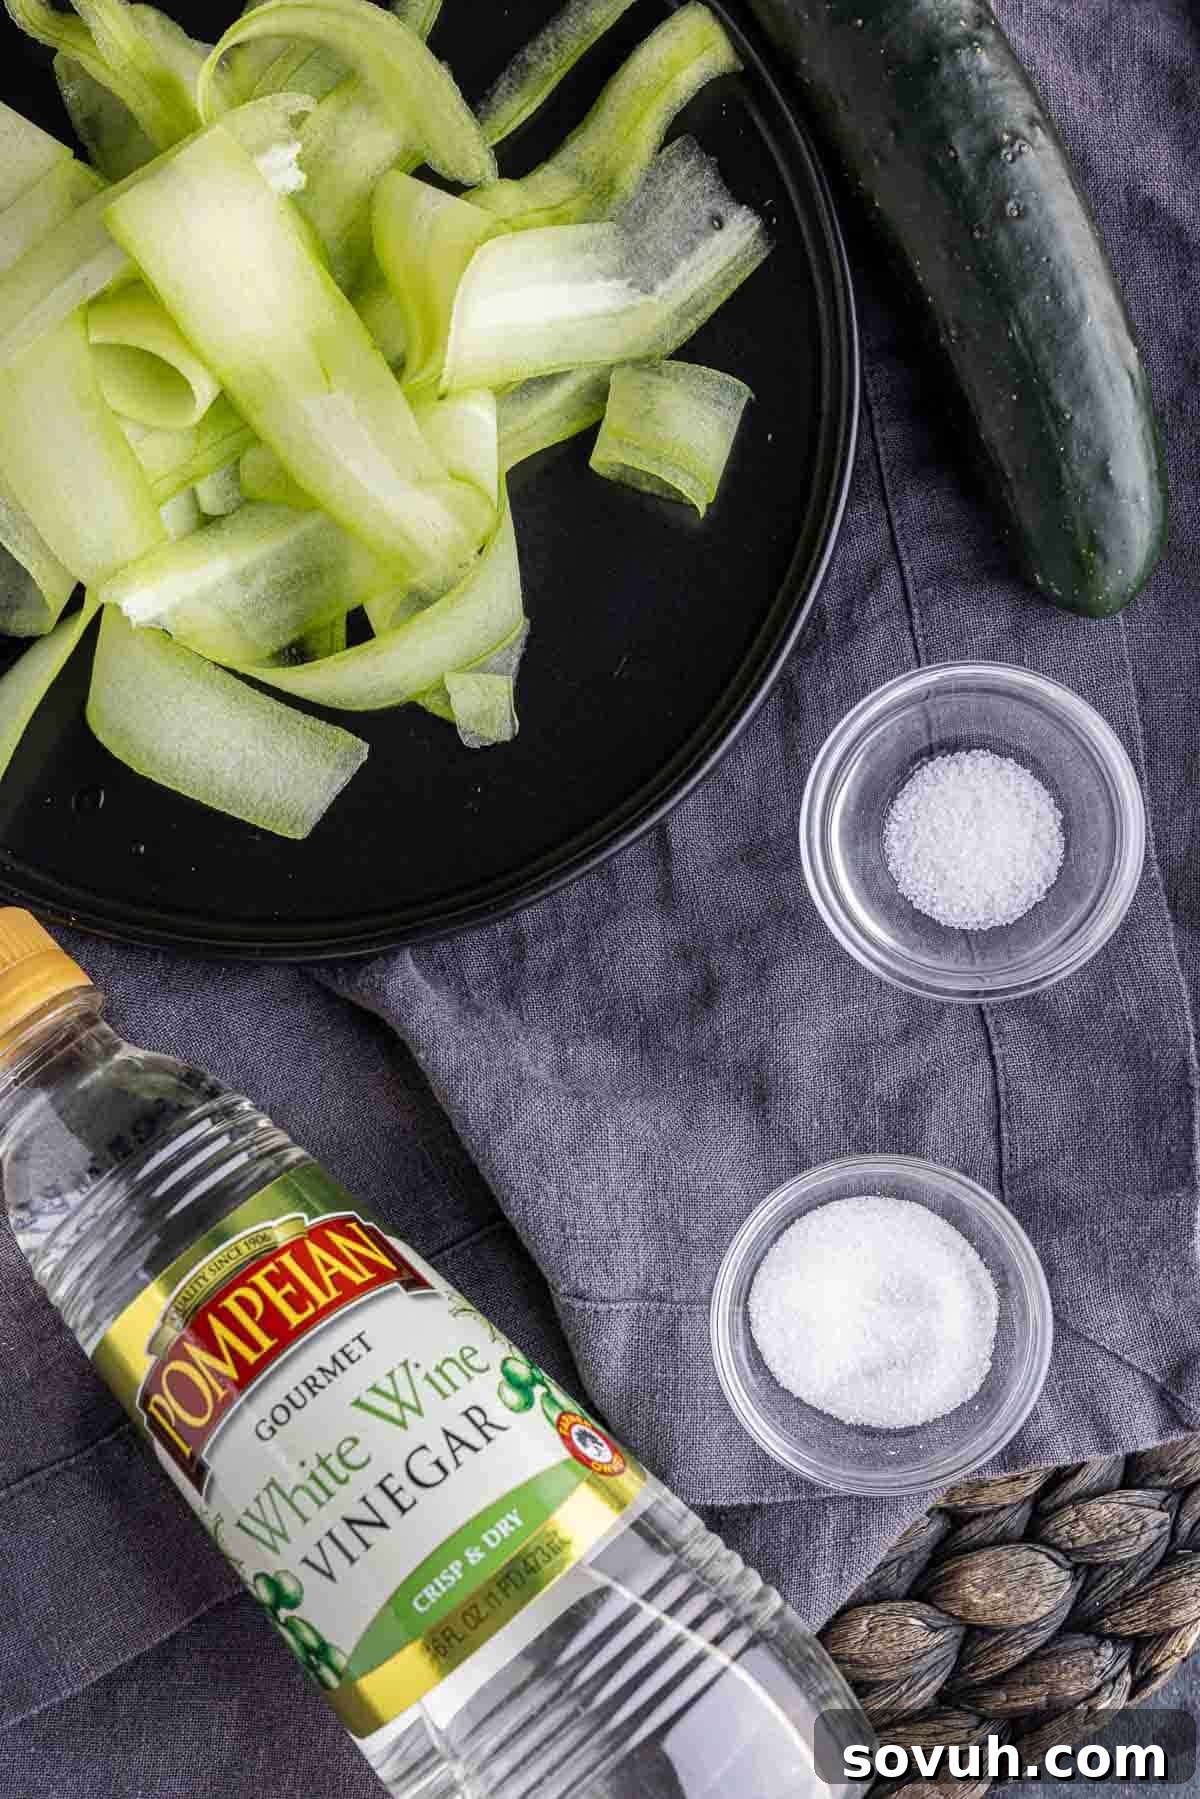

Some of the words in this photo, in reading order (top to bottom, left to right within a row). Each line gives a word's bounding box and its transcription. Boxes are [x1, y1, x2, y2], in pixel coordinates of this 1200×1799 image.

[207, 1245, 244, 1275] SINCE
[243, 1231, 273, 1251] 1906
[147, 1221, 398, 1457] POMPEIAN
[254, 1330, 373, 1442] GOURMET
[235, 1435, 372, 1556] White
[350, 1344, 491, 1431] Wine
[300, 1403, 511, 1584] VINEGAR
[412, 1558, 464, 1614] CRISP
[464, 1545, 487, 1566] &
[481, 1505, 524, 1549] DRY
